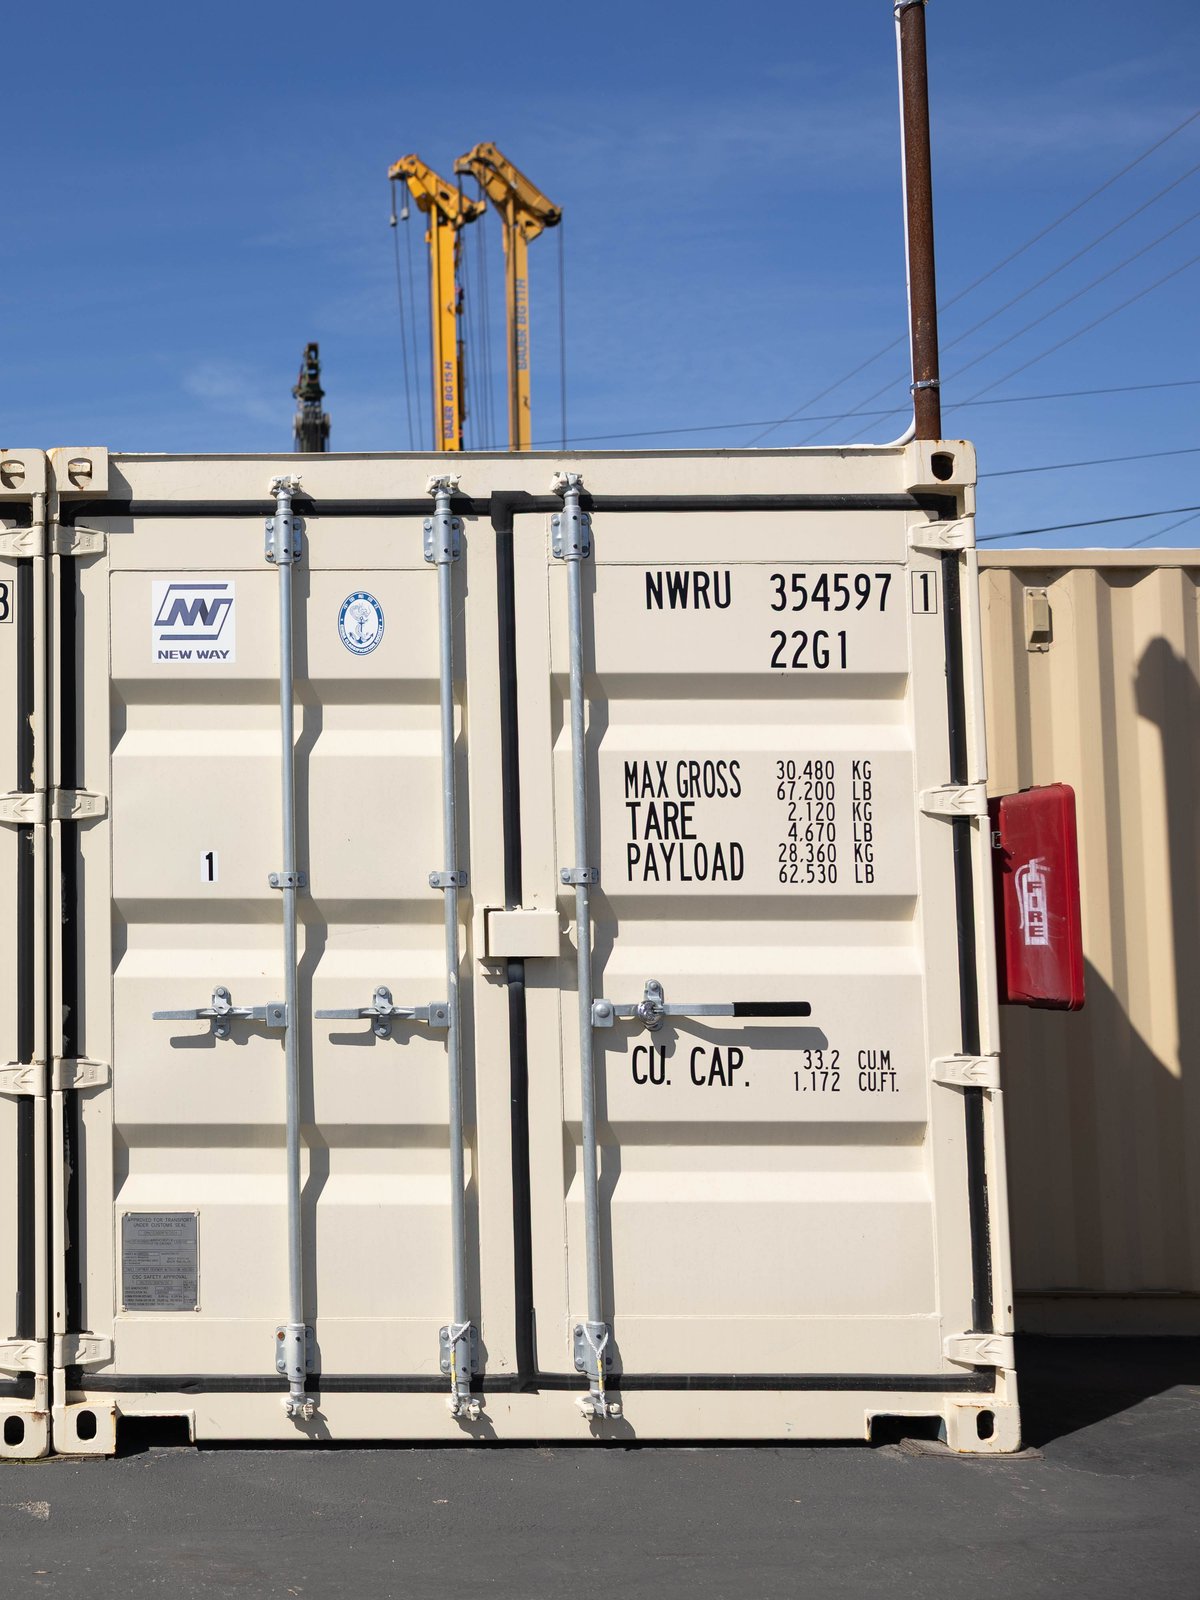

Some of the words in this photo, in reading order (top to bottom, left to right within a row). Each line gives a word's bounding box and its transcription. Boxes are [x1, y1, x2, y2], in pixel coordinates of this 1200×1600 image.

[445, 386, 453, 401] BG
[444, 406, 454, 439] BAUER
[646, 571, 731, 609] NWRU
[770, 574, 891, 611] 354597
[920, 573, 931, 612] 1
[158, 649, 193, 660] NEW
[196, 649, 230, 660] WAY
[771, 630, 846, 669] 22G1
[625, 761, 669, 798] MAX
[677, 760, 741, 798] GROSS
[777, 760, 834, 780] 30,480
[853, 760, 871, 780] KG
[777, 781, 834, 801] 67,200
[853, 781, 871, 801] LB
[626, 801, 697, 840] TARE
[788, 802, 835, 822] 2,120
[853, 802, 872, 822] KG
[788, 823, 835, 843] 4,670
[854, 823, 872, 843] LB
[627, 842, 744, 881] PAYLOAD
[779, 843, 836, 864] 28,360
[854, 843, 873, 864] KG
[206, 852, 213, 881] 1
[779, 864, 837, 884] 62,530
[855, 864, 874, 884] LB
[1026, 881, 1044, 937] FIRE
[632, 1045, 671, 1085] CU.
[690, 1046, 750, 1087] CAP.
[803, 1049, 840, 1070] 33.2
[858, 1050, 895, 1071] CU.M.
[794, 1071, 840, 1092] 1,172
[858, 1071, 899, 1092] CU.FT.
